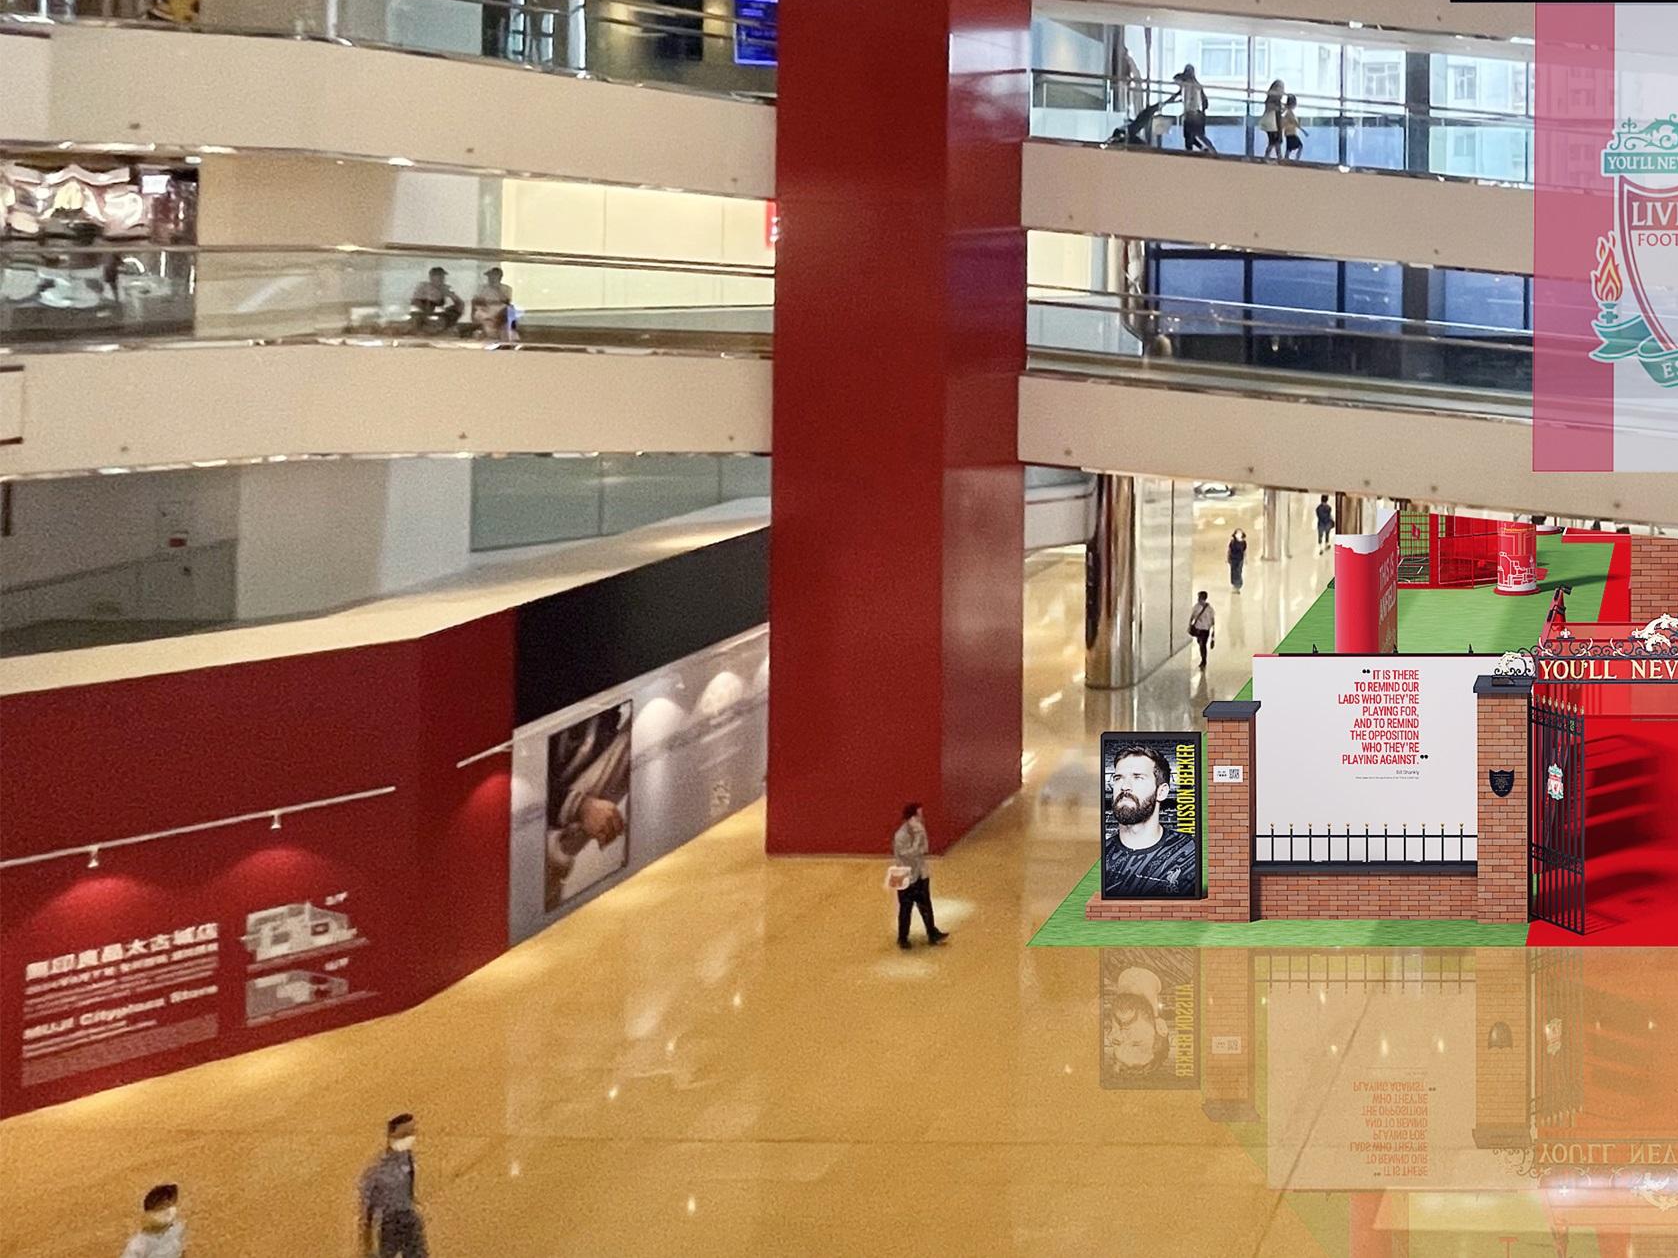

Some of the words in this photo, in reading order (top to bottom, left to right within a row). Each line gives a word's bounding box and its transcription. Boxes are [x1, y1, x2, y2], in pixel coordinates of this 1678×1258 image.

[1608, 156, 1655, 170] YOU'LL
[1383, 670, 1391, 680] IS
[1392, 670, 1419, 680] THERE
[1539, 659, 1617, 681] YOU'LL
[1354, 682, 1366, 692] TO
[1368, 682, 1400, 692] REMIND
[1402, 682, 1419, 692] OUR
[1338, 694, 1360, 704] LADS
[1361, 694, 1382, 704] WHO
[1383, 694, 1419, 704] THEY'RE
[1363, 706, 1398, 716] PLAYING
[1354, 718, 1372, 728] AND
[1373, 718, 1385, 728] TO
[1387, 718, 1419, 728] REMIND
[1350, 730, 1367, 740] THE
[1369, 730, 1419, 740] OPPOSITION
[1361, 742, 1382, 752] WHO
[1384, 742, 1419, 752] THEY'RE
[1342, 754, 1378, 764] PLAYING
[1176, 744, 1195, 786] BECKER
[1177, 789, 1195, 835] ALISSON
